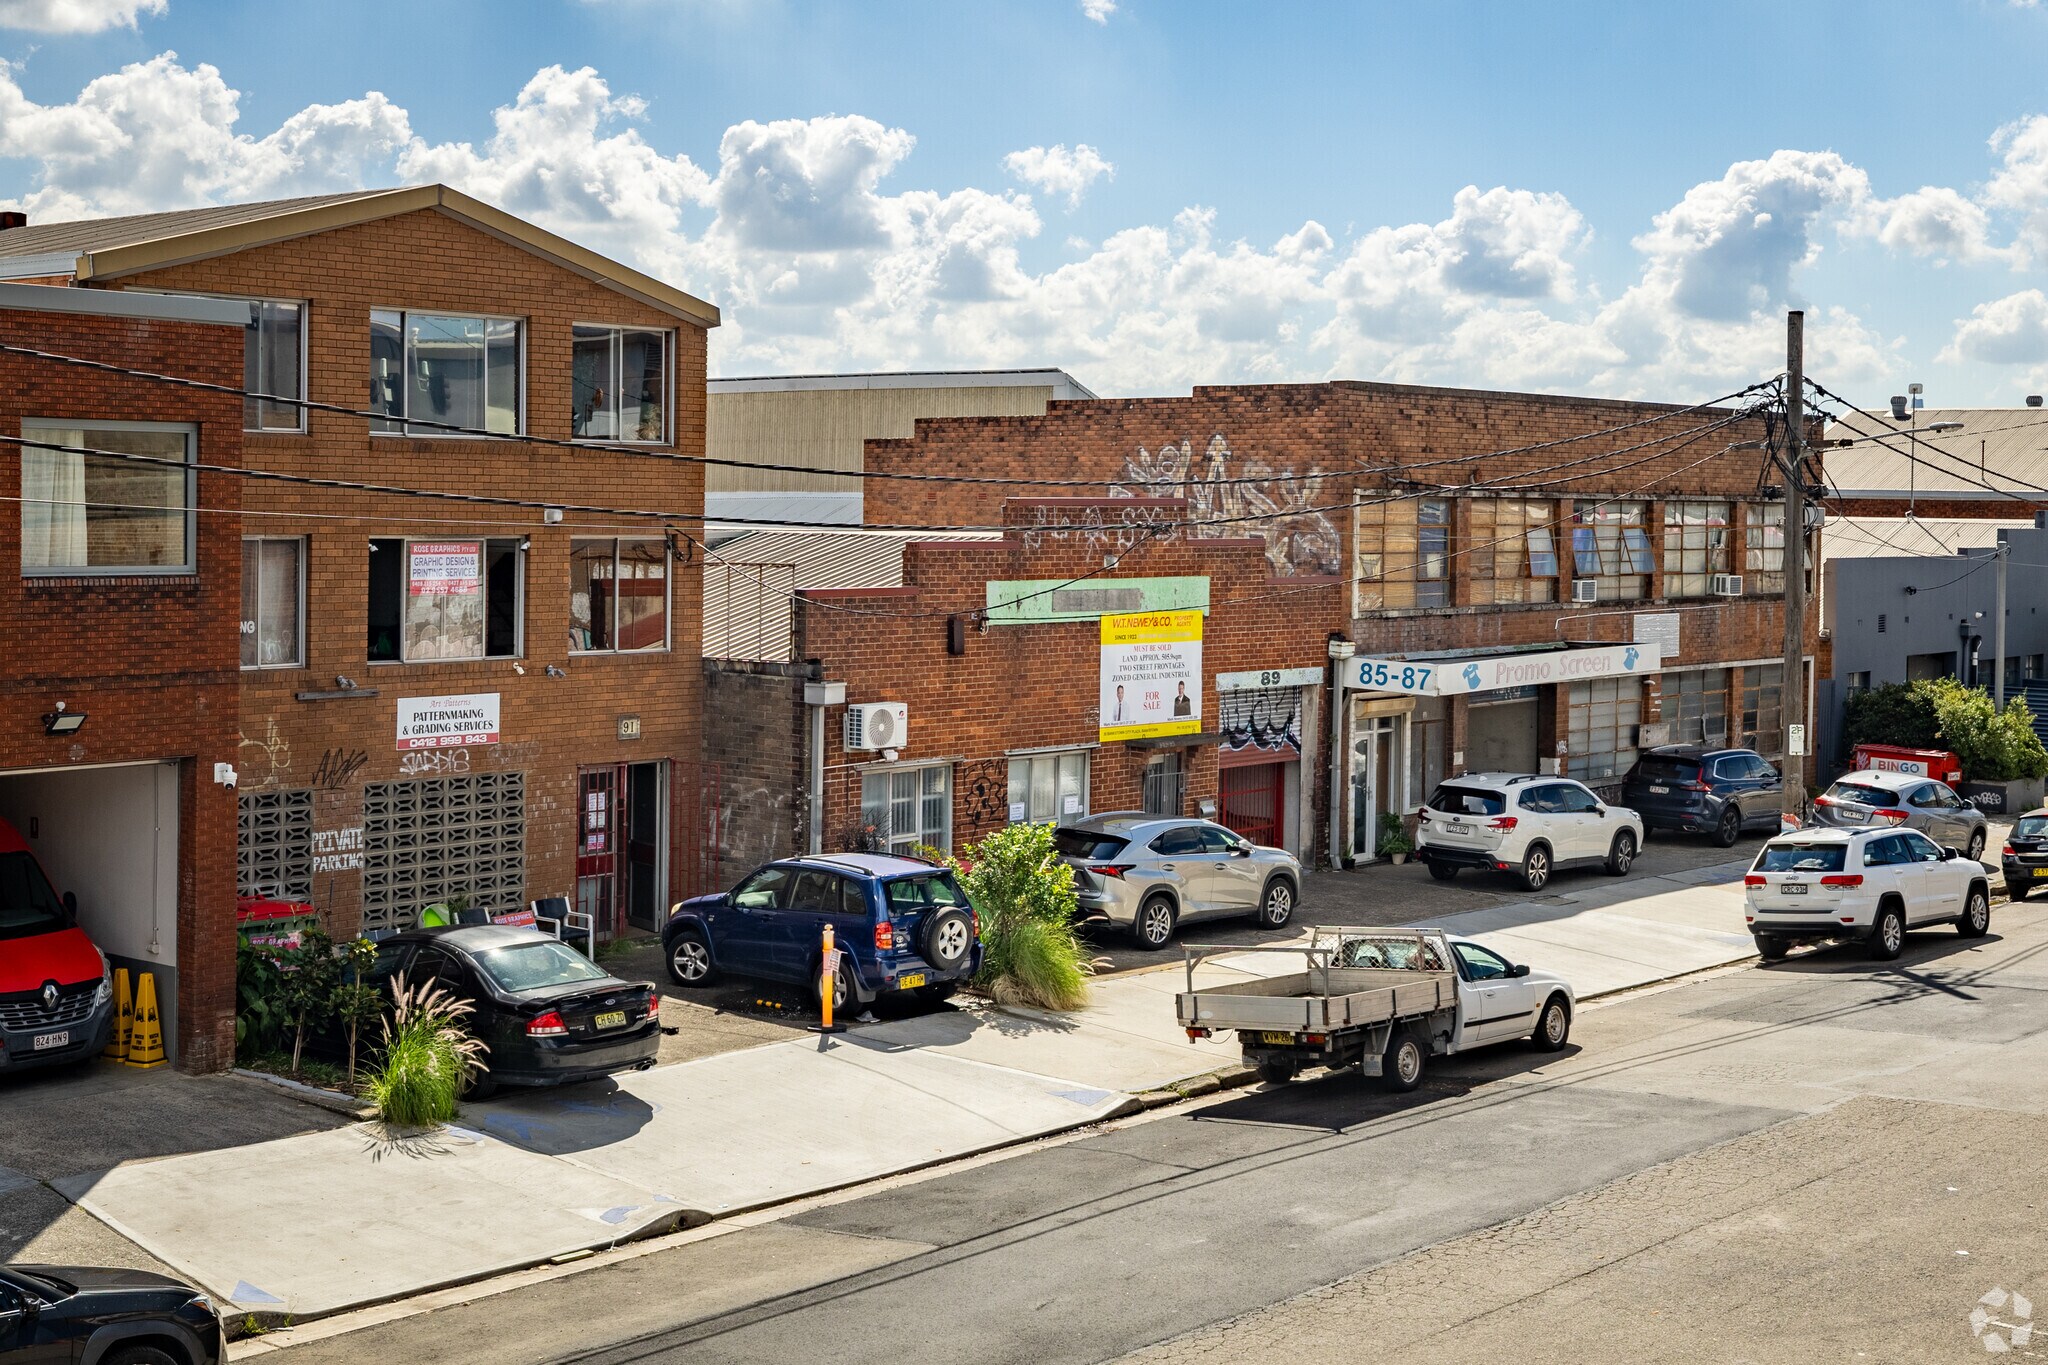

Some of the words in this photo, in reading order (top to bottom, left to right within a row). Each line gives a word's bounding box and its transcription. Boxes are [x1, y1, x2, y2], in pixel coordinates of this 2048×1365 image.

[413, 545, 430, 553] ROSE
[414, 557, 443, 567] GRAPHIC
[445, 556, 470, 566] DESIGN
[412, 568, 443, 578] PRINTING
[445, 567, 476, 577] SERVICES
[1133, 645, 1149, 653] MUST
[1122, 655, 1138, 663] LAND
[1133, 663, 1153, 671] STREET
[1154, 662, 1185, 670] FRONTAGES
[1495, 661, 1551, 685] Promo
[1559, 654, 1611, 676] Screen
[1112, 674, 1132, 682] ZONED
[1132, 673, 1158, 681] GENERAL
[1159, 671, 1191, 679] INDUSTRIAL
[1261, 671, 1280, 686] 89
[1359, 662, 1431, 690] 85-87
[1145, 691, 1160, 701] FOR
[1143, 700, 1160, 711] SALE
[413, 708, 484, 722] PATTERNMAKING
[402, 725, 409, 735] &
[412, 722, 451, 735] GRADING
[453, 719, 494, 732] SERVICES
[623, 721, 634, 733] 91
[409, 737, 437, 748] 0412
[440, 735, 462, 745] 999
[465, 734, 487, 743] 843
[1877, 760, 1919, 773] BINGO
[311, 827, 364, 853] PRIVATE
[313, 852, 364, 872] PARKING
